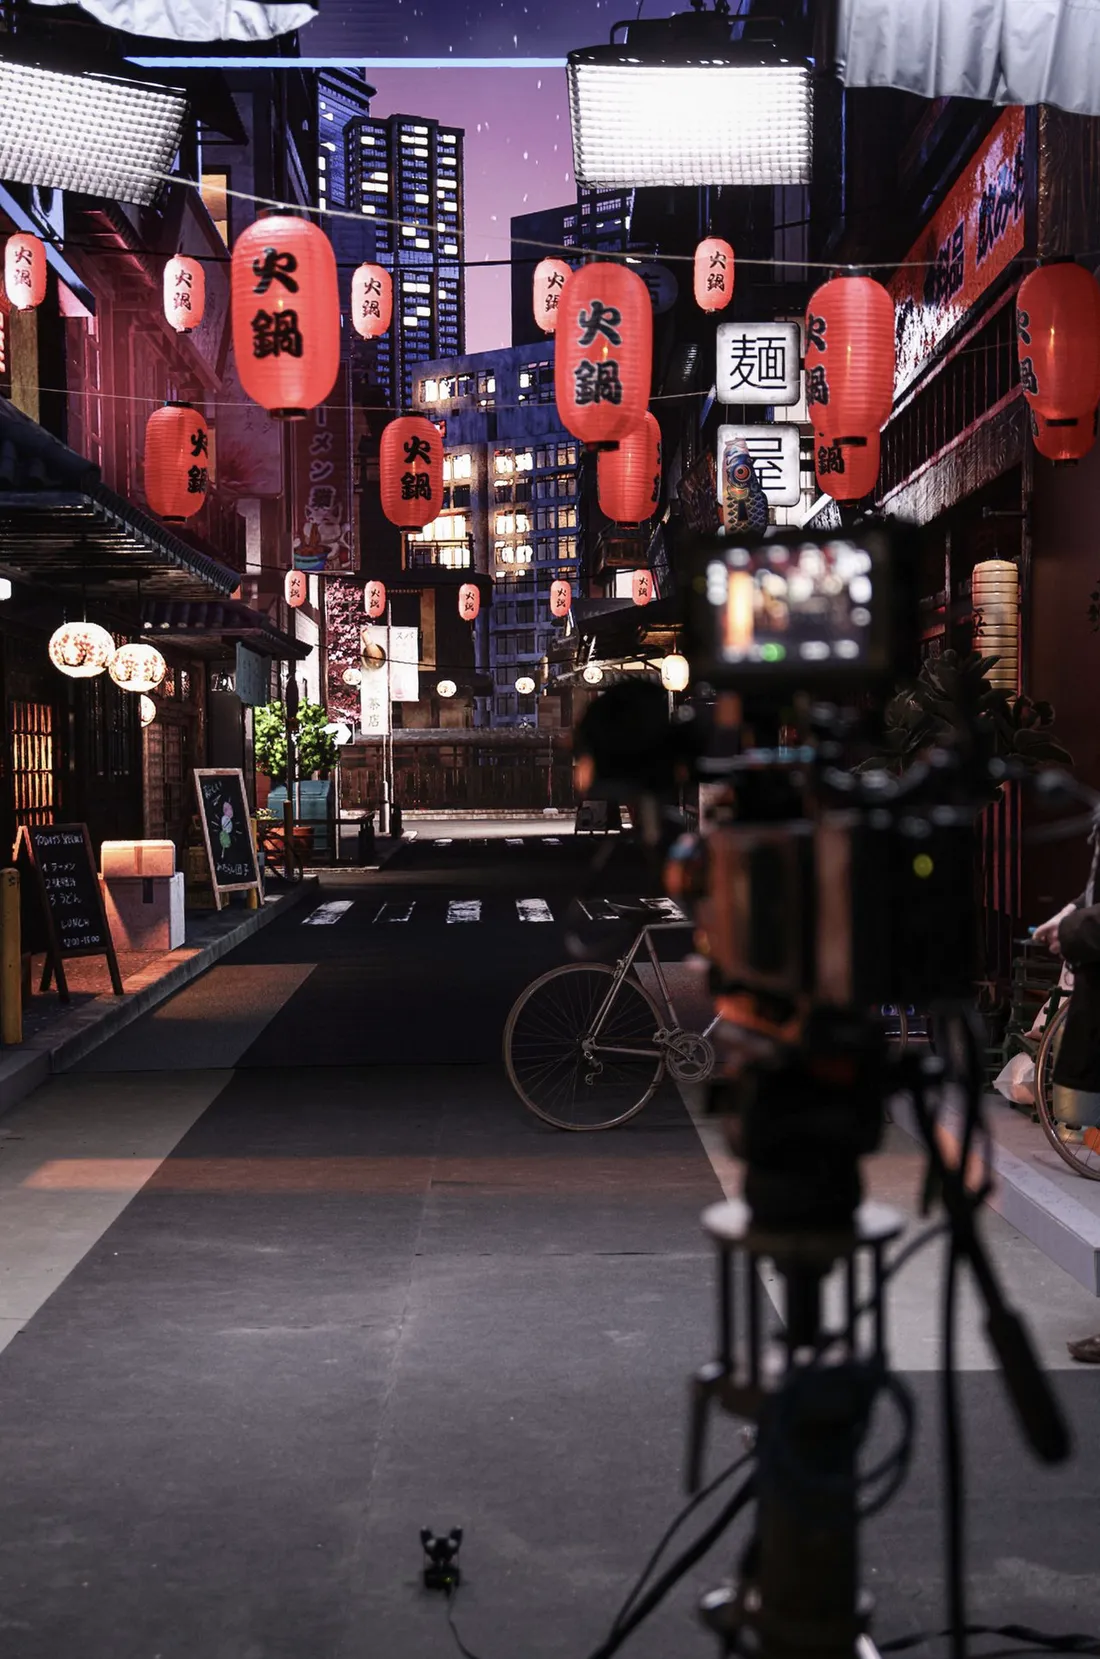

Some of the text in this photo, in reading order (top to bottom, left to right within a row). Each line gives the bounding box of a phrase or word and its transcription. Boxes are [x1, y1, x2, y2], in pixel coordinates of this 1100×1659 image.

[13, 246, 33, 288] 火鍋
[707, 251, 726, 292] 火鍋
[173, 270, 193, 311] 火鍋
[251, 247, 303, 359] 火鍋
[362, 277, 382, 318] 火鍋
[575, 300, 623, 406] 火鍋
[400, 435, 432, 501] 火鍋
[818, 432, 845, 475] 鍋
